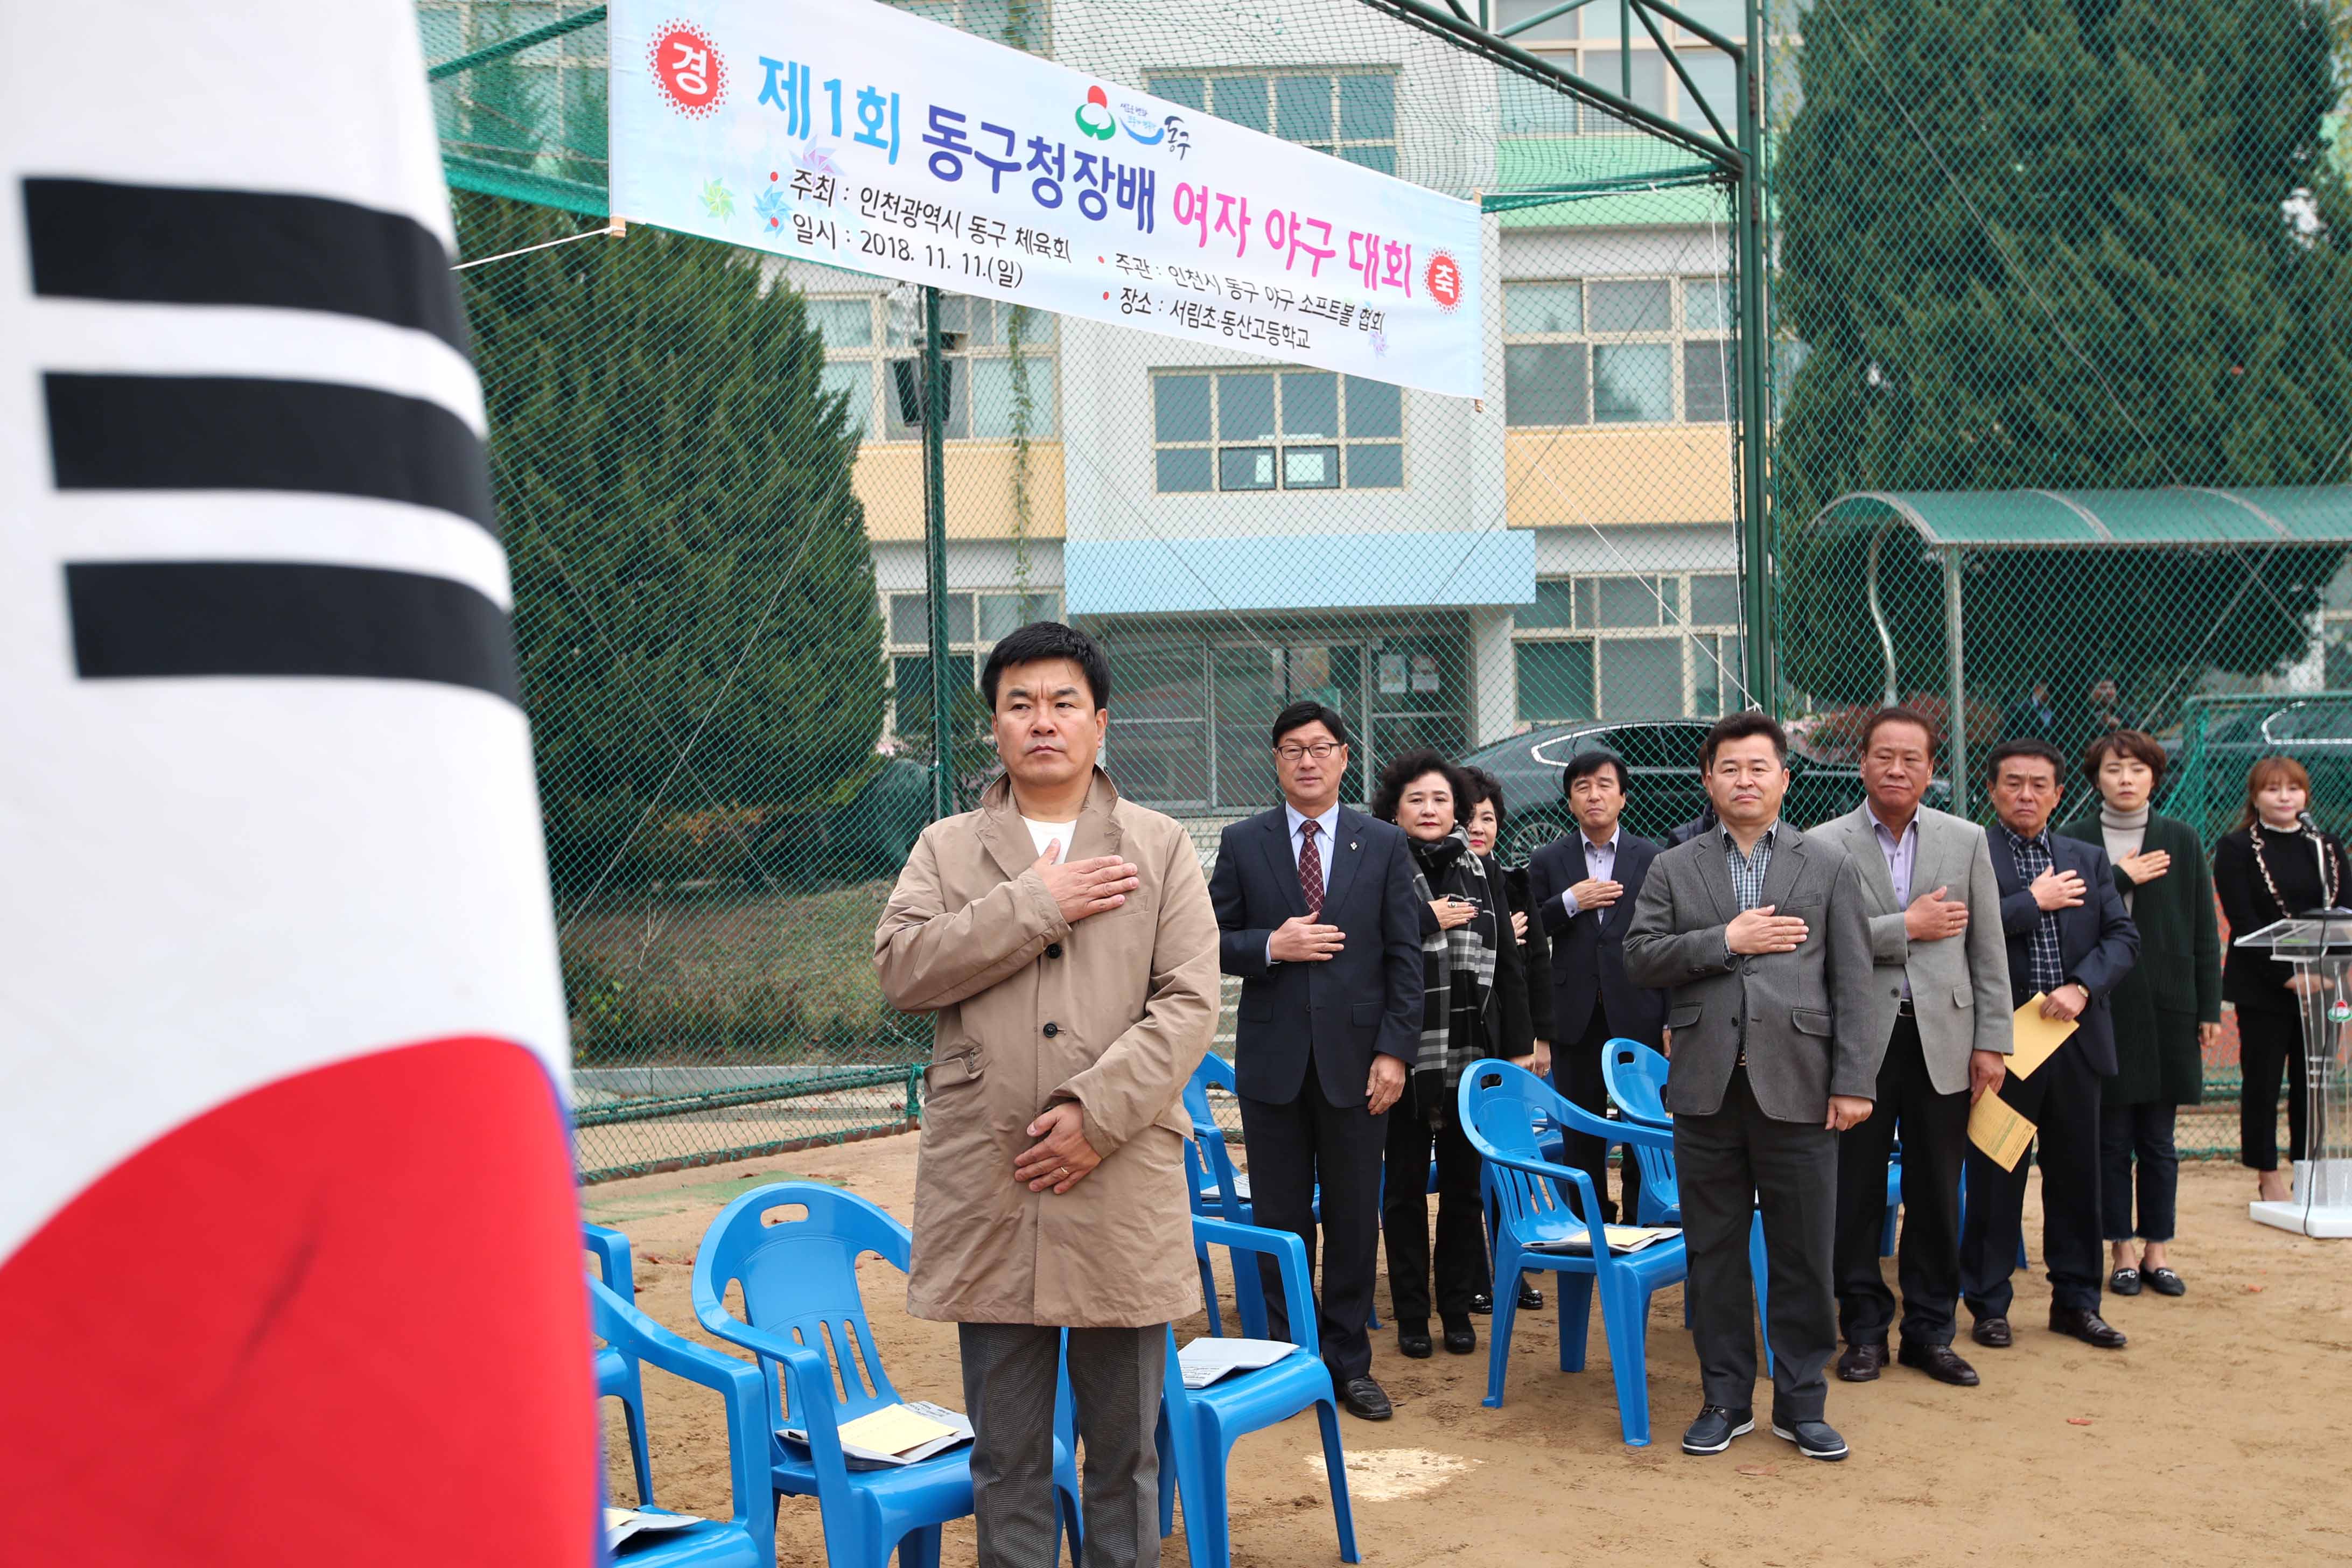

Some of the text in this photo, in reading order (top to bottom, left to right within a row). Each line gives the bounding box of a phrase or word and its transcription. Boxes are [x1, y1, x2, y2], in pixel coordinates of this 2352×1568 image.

[672, 41, 709, 95] 경
[1164, 116, 1191, 160] 동구
[758, 56, 1411, 298] 제1회 동구청장배 여자 야구 대회
[790, 169, 836, 208] 주최
[860, 187, 961, 239] 인천광역시
[968, 215, 1006, 248] 동구
[1014, 227, 1072, 263] 체육회
[793, 214, 836, 250] 일시
[860, 230, 914, 261] 2018.
[926, 245, 951, 269] 11.
[1116, 253, 1153, 280] 주관
[1168, 265, 1221, 296] 인천시
[1225, 277, 1259, 303] 동구
[1265, 286, 1295, 312] 야구
[1298, 294, 1355, 327] 소프트볼
[1359, 307, 1385, 334] 협회
[1120, 287, 1152, 315] 장소
[1434, 264, 1454, 299] 축
